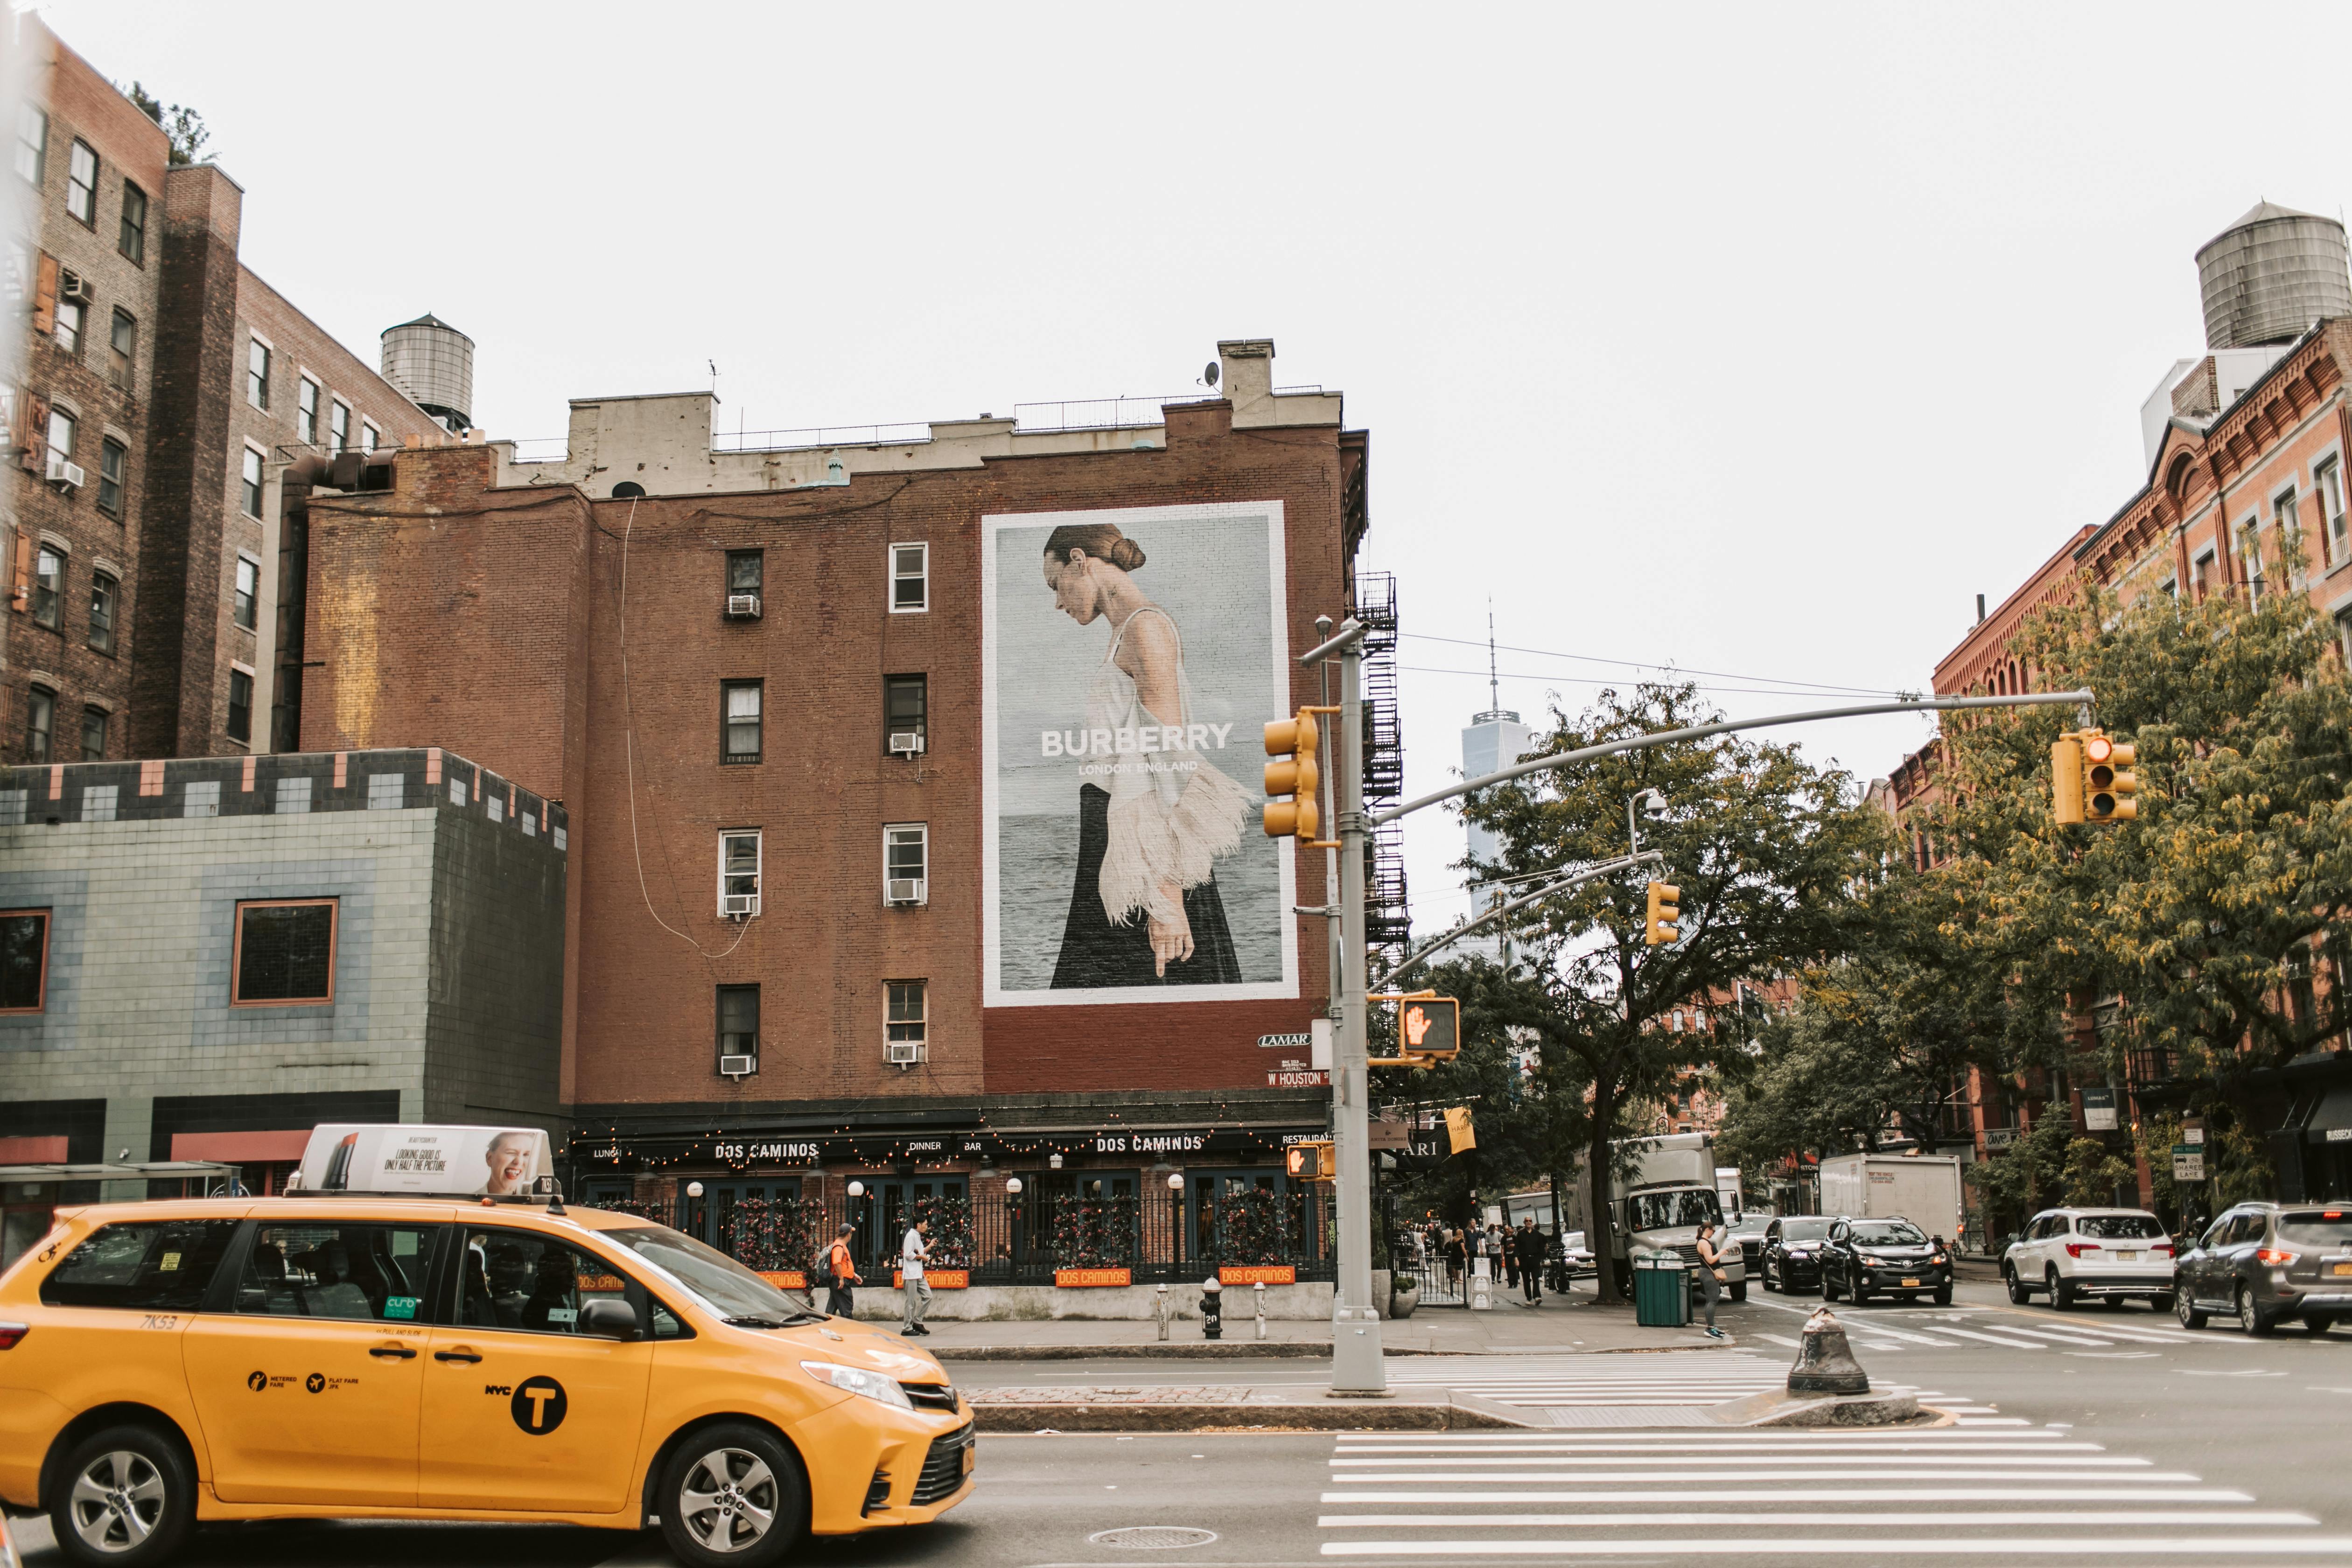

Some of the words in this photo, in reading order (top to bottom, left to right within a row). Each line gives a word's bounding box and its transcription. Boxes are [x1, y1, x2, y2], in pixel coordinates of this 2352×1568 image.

[1042, 722, 1234, 756] BURBERRY
[1078, 763, 1131, 776] LONDON
[1137, 761, 1198, 773] ENGLAND
[1261, 1034, 1308, 1045] LAMAR
[1268, 1073, 1276, 1085] W
[1280, 1072, 1321, 1085] HOUSTON
[715, 1145, 743, 1158] DOS
[750, 1143, 818, 1157] CAMINOS
[910, 1141, 941, 1151] DINNER
[965, 1142, 981, 1151] BAR
[1097, 1138, 1126, 1152] DOS
[1133, 1136, 1202, 1151] CAMINOS
[396, 1148, 419, 1160] LOOKING
[419, 1149, 434, 1160] GOOD
[434, 1149, 441, 1160] IS
[385, 1159, 399, 1170] ONLY
[399, 1160, 413, 1170] HALF
[413, 1160, 424, 1170] THE
[424, 1161, 447, 1171] PICTURE
[541, 1177, 552, 1193] 7K53
[1059, 1272, 1078, 1284] DOS
[1081, 1271, 1127, 1283] CAMINOS
[1222, 1270, 1242, 1282] DOS
[1245, 1269, 1291, 1281] CAMINOS
[388, 1298, 415, 1308] curb
[140, 1315, 178, 1330] 7K53
[485, 1385, 511, 1396] NYC
[525, 1387, 556, 1428] T
